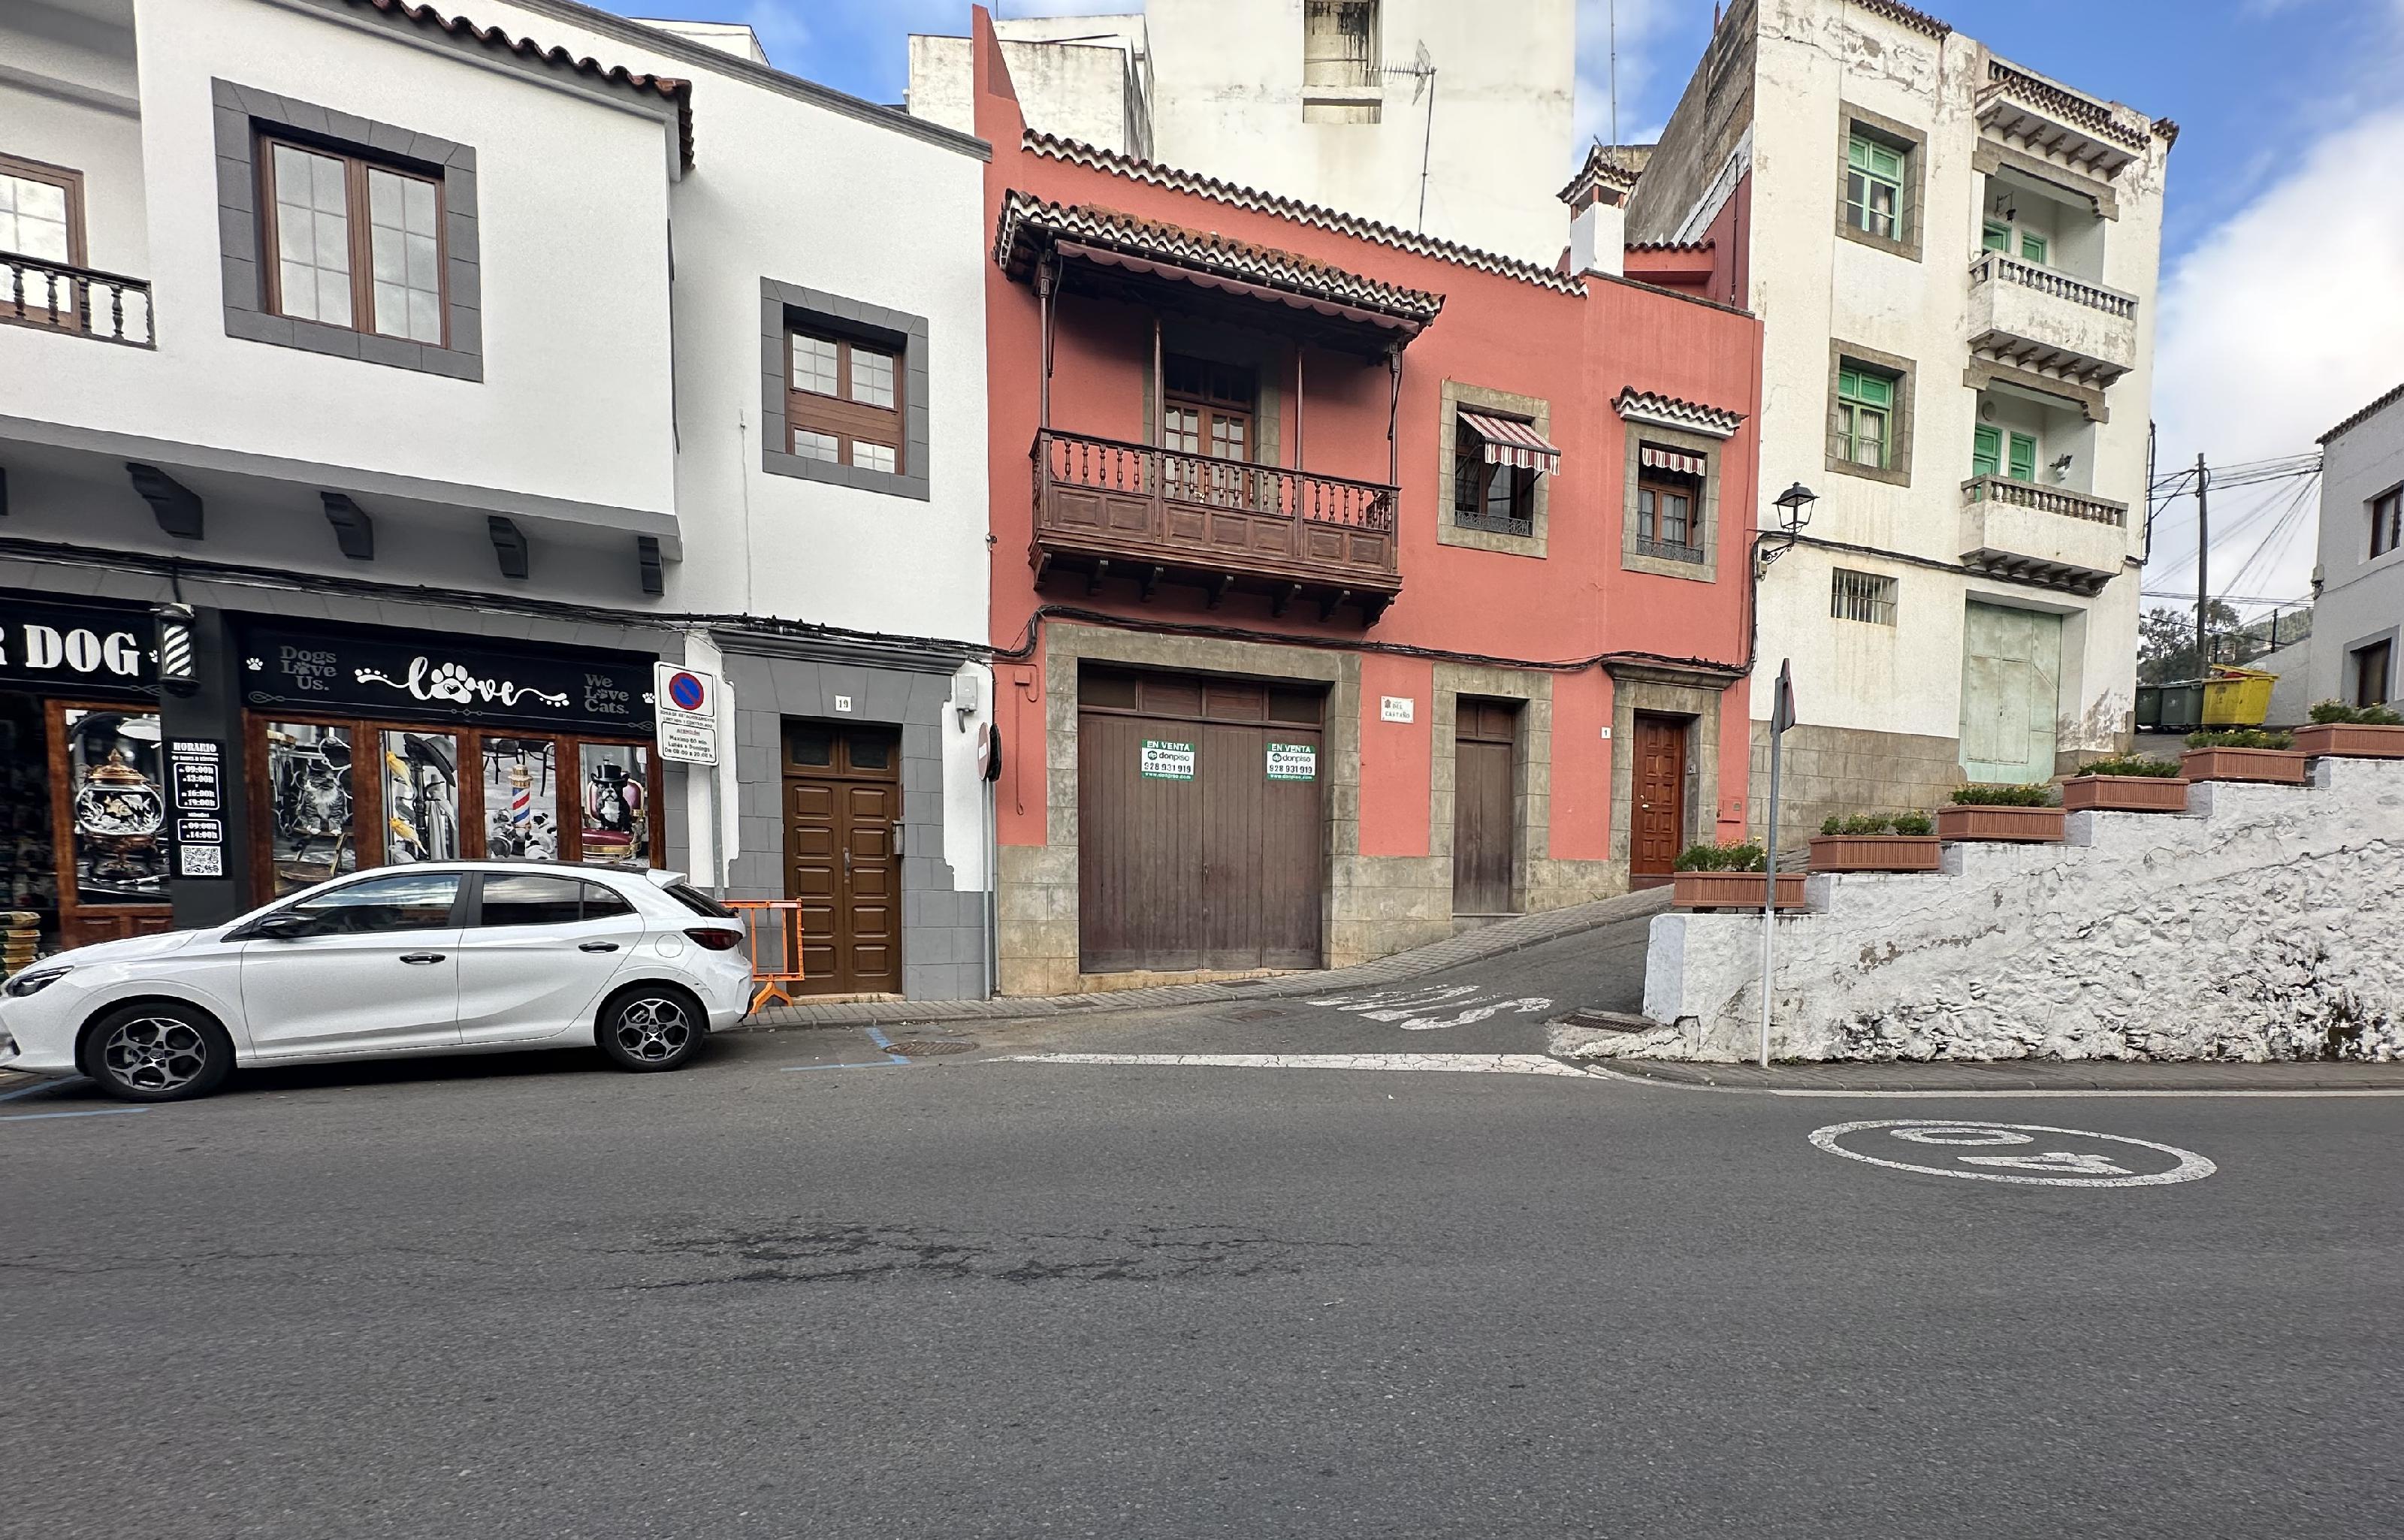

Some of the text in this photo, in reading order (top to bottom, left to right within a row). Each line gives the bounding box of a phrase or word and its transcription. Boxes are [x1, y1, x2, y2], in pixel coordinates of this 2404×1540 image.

[23, 624, 140, 676] DOG
[280, 646, 337, 665] Dogs
[297, 675, 329, 690] Us.
[584, 673, 613, 688] We
[584, 699, 630, 714] Cats.
[839, 699, 849, 708] 19
[173, 742, 216, 753] HORARIO
[1161, 742, 1190, 751] VENTA
[1285, 744, 1311, 753] VENTA
[1159, 752, 1189, 761] donpiso
[1282, 754, 1311, 763] donpiso
[1144, 762, 1159, 770] 928
[1178, 765, 1191, 773] 919
[1285, 765, 1298, 773] 931
